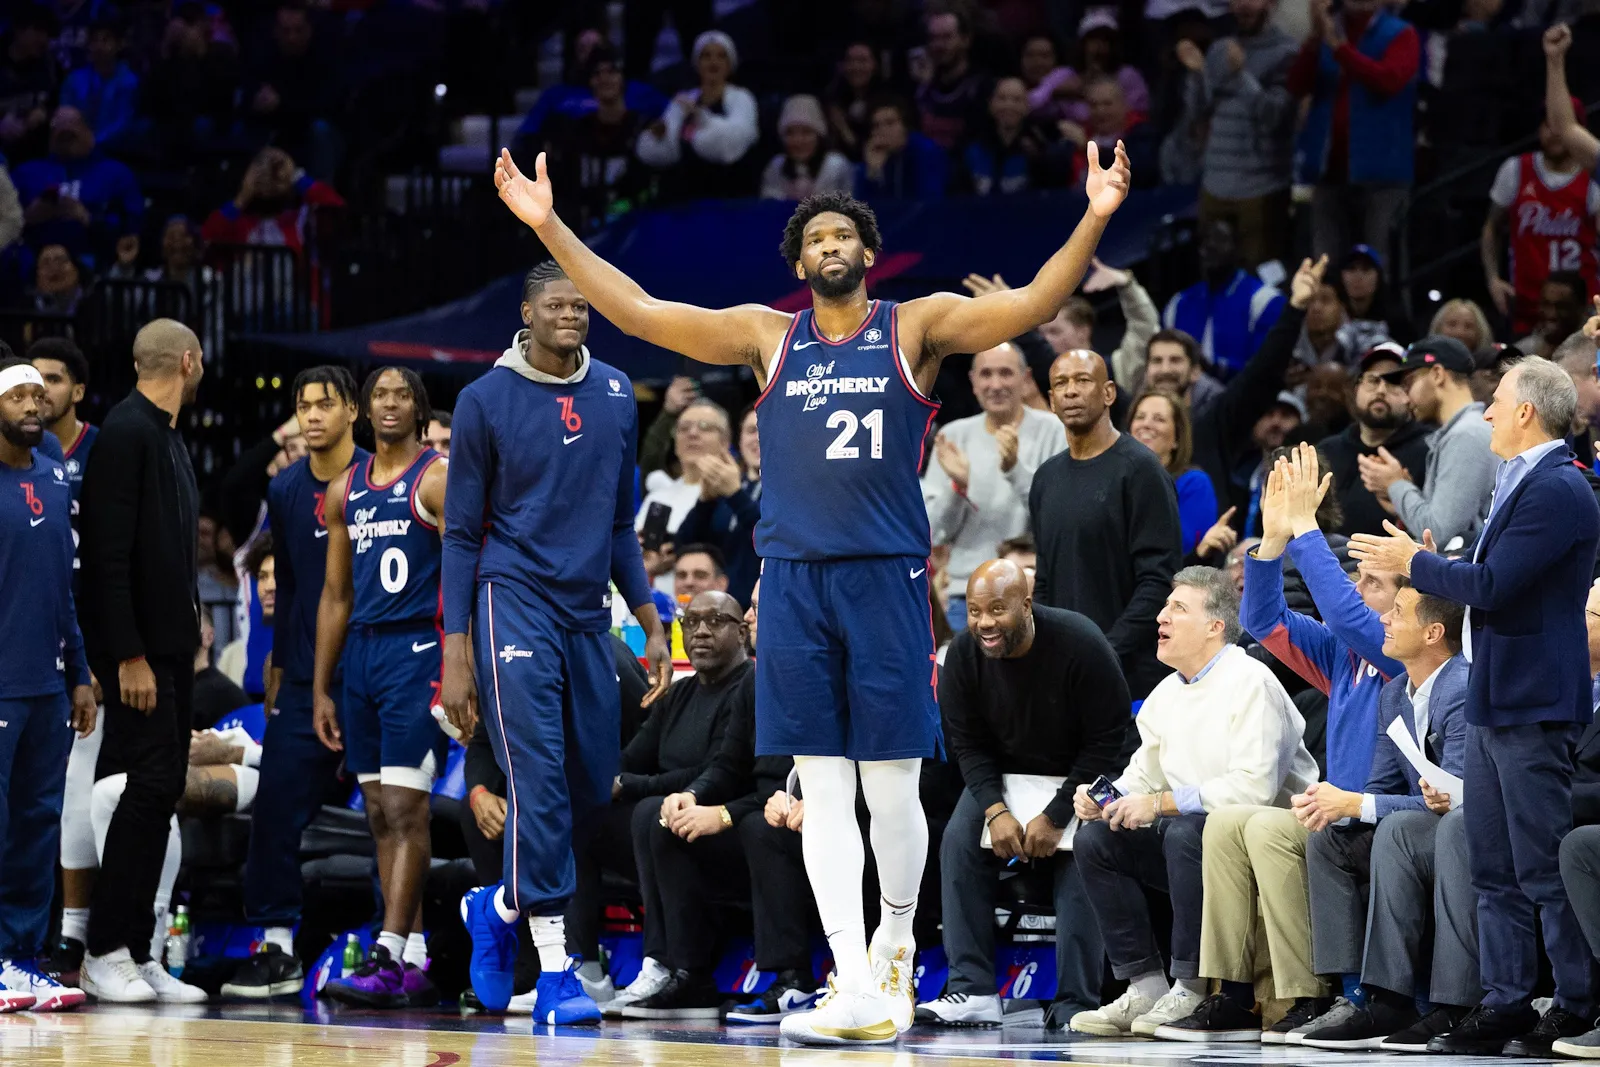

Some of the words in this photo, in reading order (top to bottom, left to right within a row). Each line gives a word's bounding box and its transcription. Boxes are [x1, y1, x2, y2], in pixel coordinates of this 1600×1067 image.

[1549, 239, 1581, 271] 12
[857, 343, 889, 351] crypto.com
[785, 377, 890, 397] BROTHERLY
[806, 363, 825, 380] City
[556, 396, 582, 431] 76
[802, 393, 828, 412] Love
[825, 408, 884, 460] 21
[20, 482, 43, 515] 76
[347, 519, 411, 541] ROTHERLY
[380, 547, 409, 594] 0
[999, 961, 1038, 999] 76
